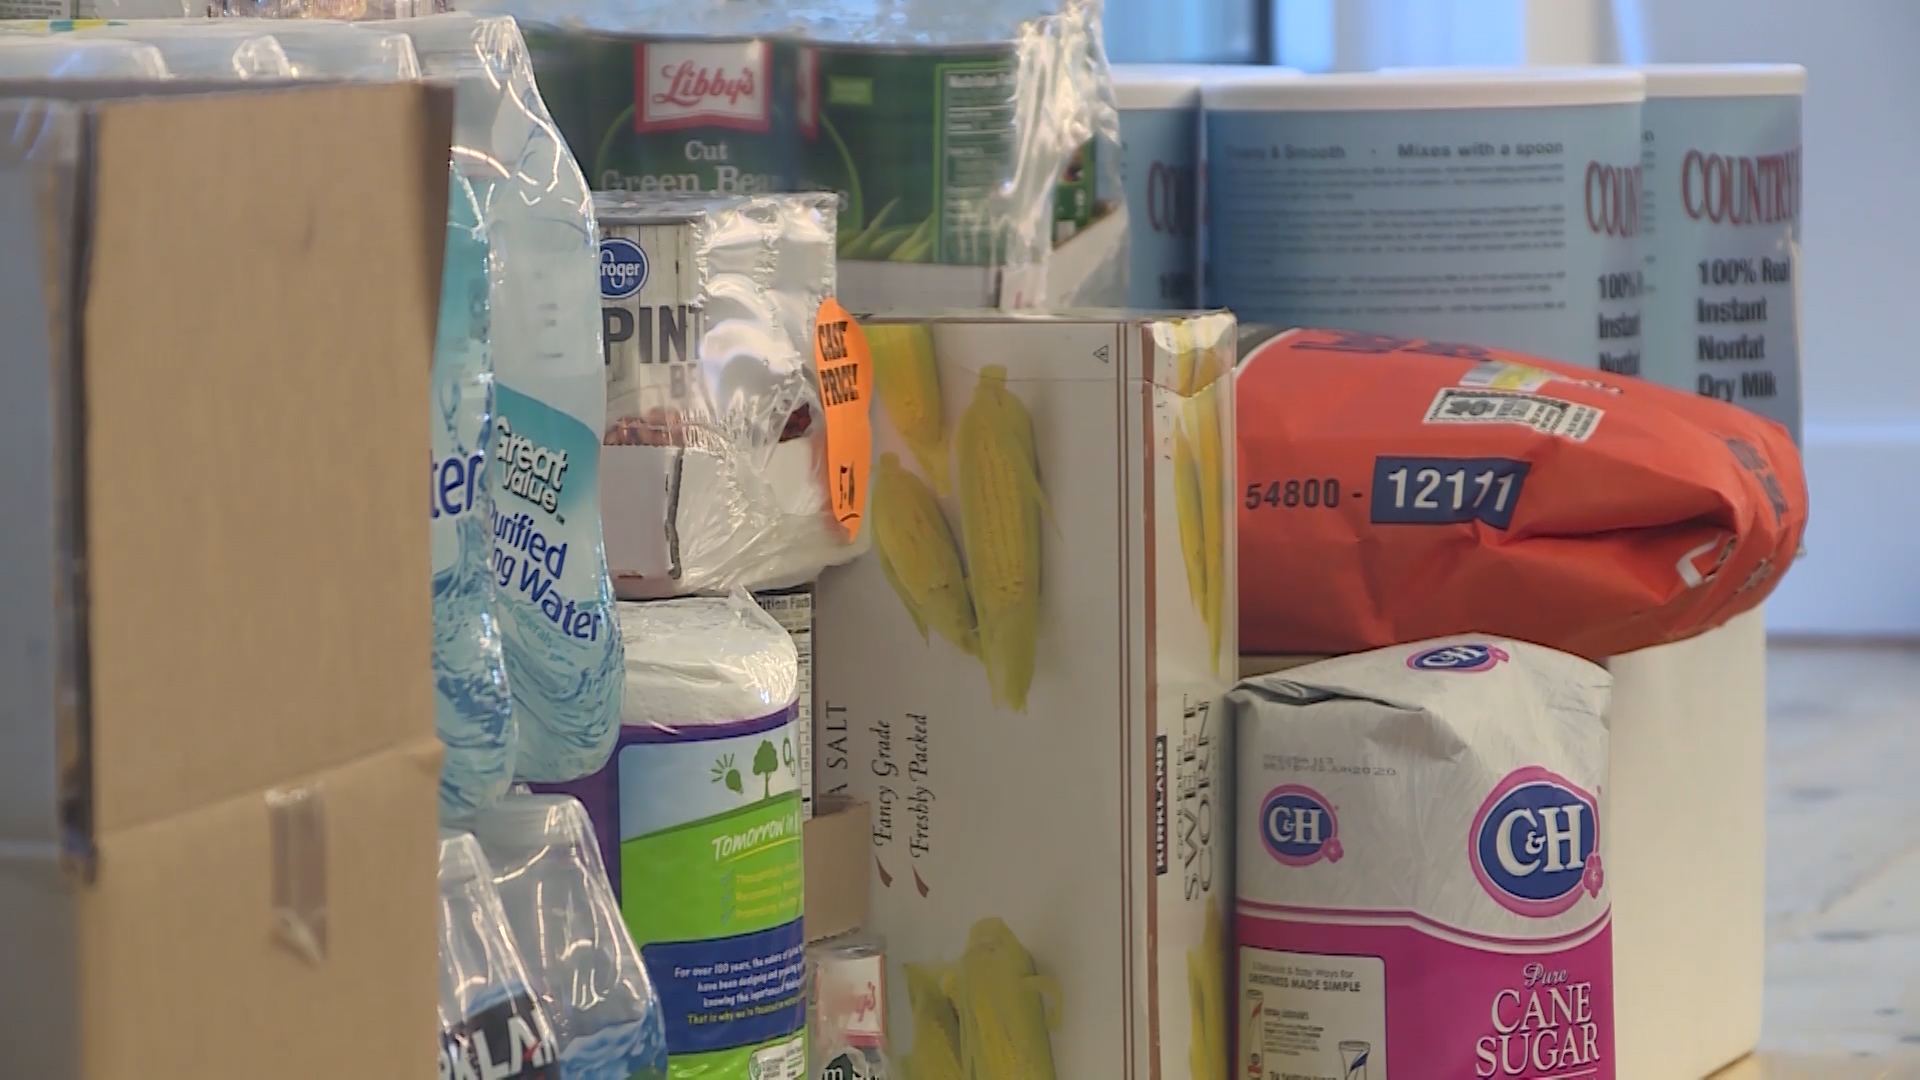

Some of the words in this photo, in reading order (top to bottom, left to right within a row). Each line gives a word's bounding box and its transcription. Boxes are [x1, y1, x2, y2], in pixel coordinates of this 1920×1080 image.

[653, 59, 754, 107] Libby's
[684, 140, 728, 160] Cut
[1397, 142, 1451, 158] Mixes
[1457, 140, 1494, 156] with
[1516, 142, 1563, 158] spoon
[601, 169, 700, 192] Green
[600, 262, 641, 288] roger
[1698, 258, 1757, 286] 100%
[1761, 256, 1790, 283] Real
[1697, 297, 1768, 323] Instant
[817, 320, 849, 362] CASE
[1697, 333, 1766, 361] Nonfat
[1698, 372, 1737, 402] Dry
[1742, 370, 1777, 399] Milk
[1245, 478, 1340, 510] 54800
[1388, 467, 1516, 512] 12111
[519, 558, 602, 643] Water
[1423, 645, 1486, 668] C&H
[826, 700, 848, 770] SALT
[869, 719, 898, 778] Grade
[905, 712, 929, 782] Packed
[872, 785, 899, 847] Fancy
[1155, 740, 1165, 868] KIRKLAND
[1183, 693, 1199, 901] SWEET
[1197, 701, 1214, 893] CORN
[712, 819, 785, 863] Tomorrow
[907, 785, 936, 858] Freshly
[1269, 805, 1322, 845] C&H
[1496, 804, 1585, 877] C&H
[1290, 979, 1320, 991] MADE
[1322, 980, 1361, 992] SIMPLE
[1523, 962, 1568, 989] Pure
[1491, 981, 1593, 1035] CANE
[1475, 1022, 1601, 1078] SUGAR
